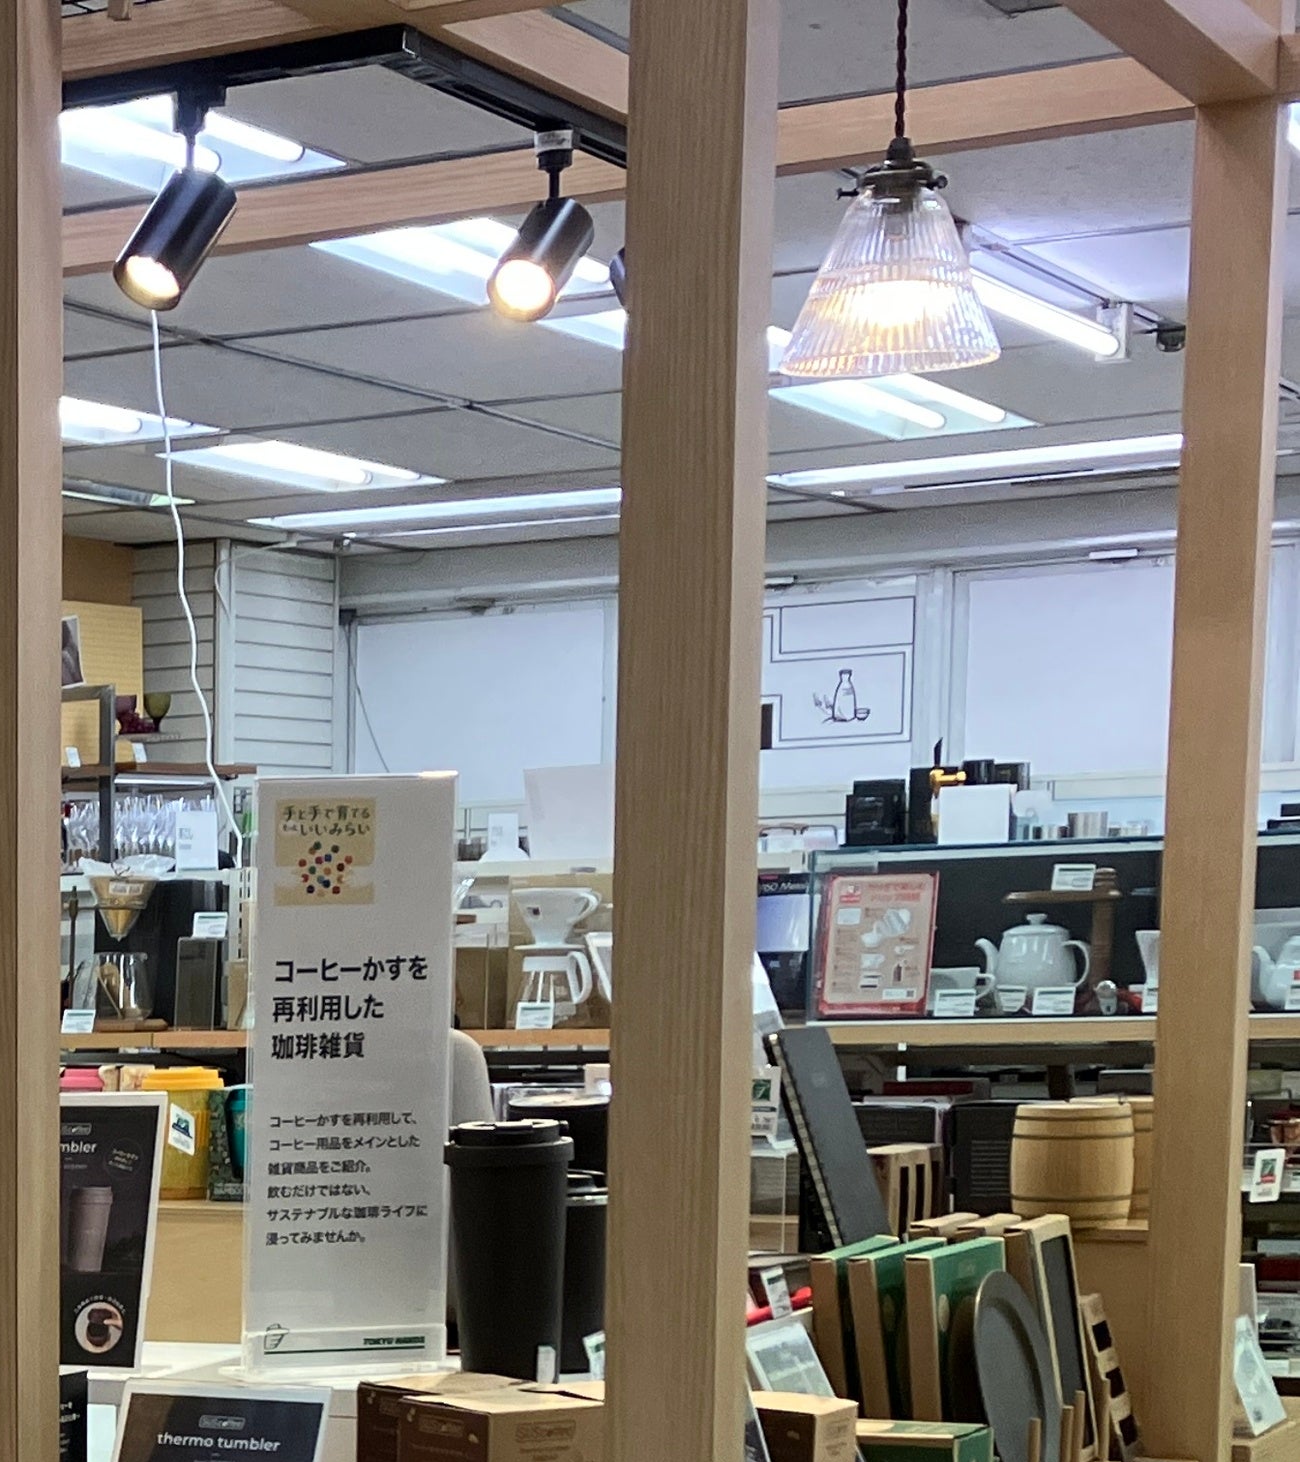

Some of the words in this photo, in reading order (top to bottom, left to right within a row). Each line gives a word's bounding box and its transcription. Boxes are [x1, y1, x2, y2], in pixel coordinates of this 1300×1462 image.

[282, 804, 371, 822] 手と手で育てる
[274, 955, 429, 983] コーヒーかすを
[272, 994, 385, 1023] 再利用した
[271, 1031, 365, 1060] 珈琲雑貨
[270, 1111, 417, 1128] コーヒーかすを再利用して、
[60, 1141, 98, 1154] mbler
[269, 1134, 421, 1151] コーヒー用品をメインとした
[268, 1159, 371, 1176] 雑貨商品をご紹介。
[267, 1184, 371, 1198] 飲むだけではない、
[266, 1205, 428, 1221] サステナブルな珈琲ライフに
[265, 1230, 366, 1246] 浸ってみませんか。
[157, 1432, 214, 1448] thermo
[217, 1437, 281, 1452] tumbler
